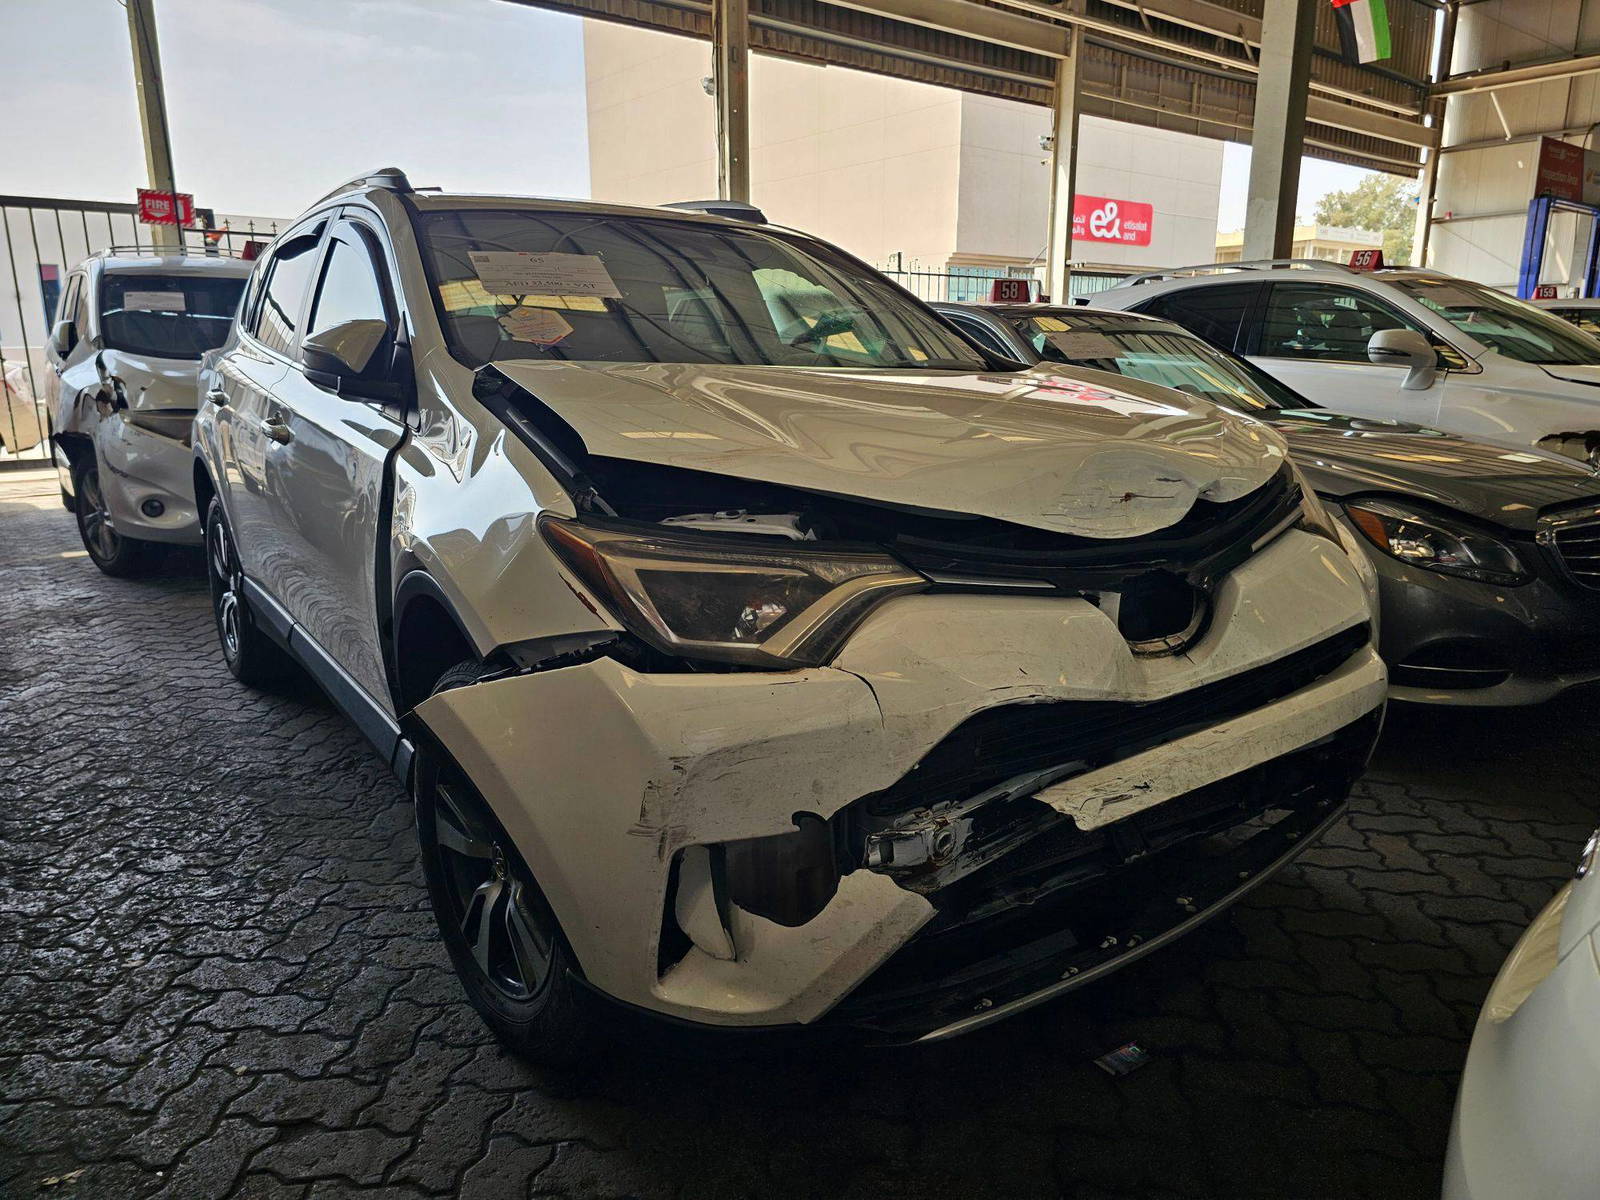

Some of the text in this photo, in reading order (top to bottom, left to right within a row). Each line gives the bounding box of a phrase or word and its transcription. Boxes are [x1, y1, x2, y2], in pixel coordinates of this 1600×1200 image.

[145, 199, 170, 211] FIRE
[1123, 221, 1147, 231] etisalat
[1123, 231, 1136, 240] and
[1355, 251, 1372, 266] 56
[1001, 281, 1019, 299] 58
[1540, 287, 1554, 298] 159
